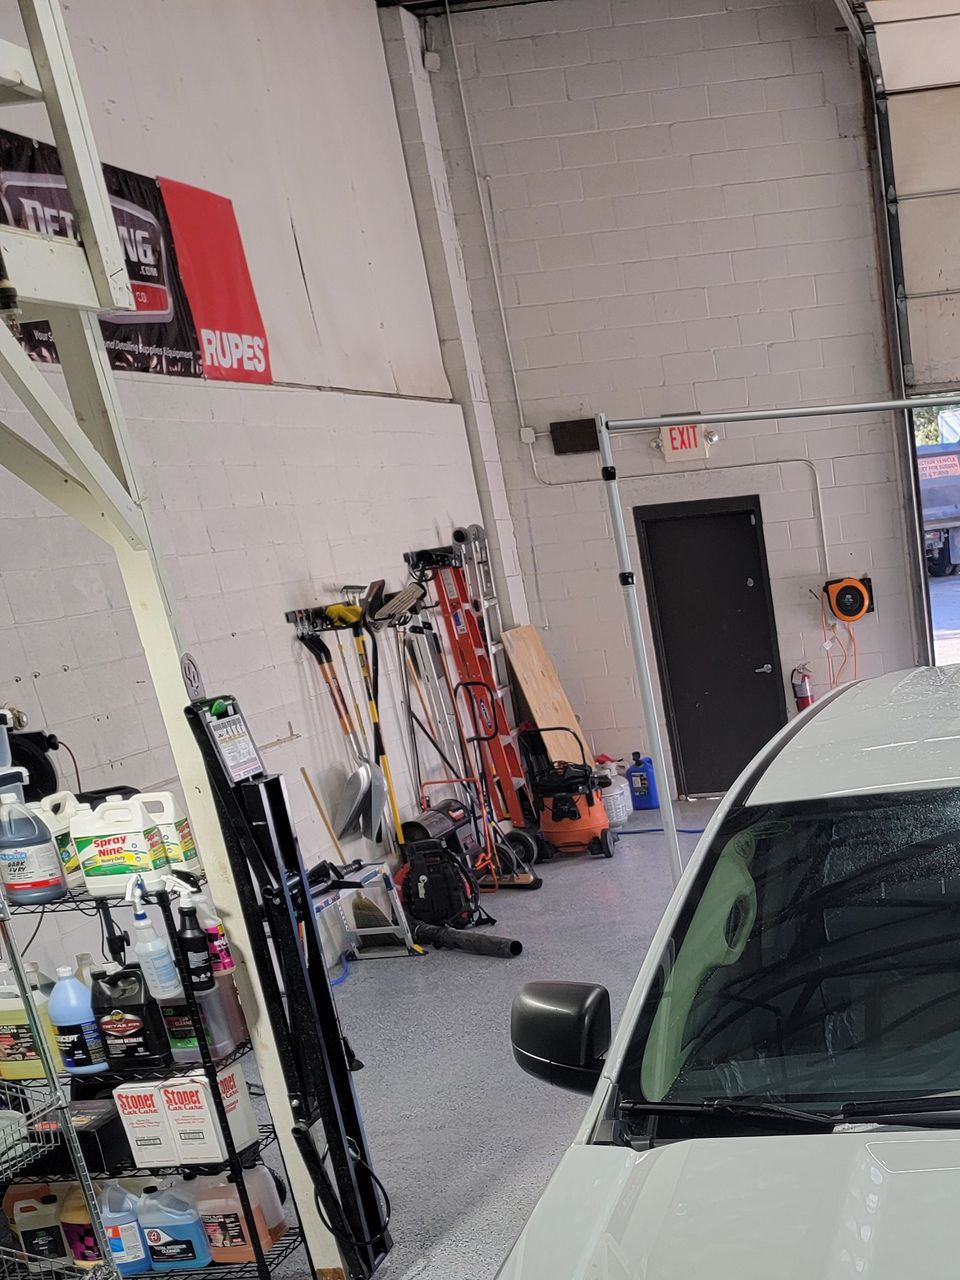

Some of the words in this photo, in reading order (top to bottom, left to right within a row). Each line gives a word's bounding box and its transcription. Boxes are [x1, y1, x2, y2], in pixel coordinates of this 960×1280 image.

[201, 328, 265, 373] RUPES
[668, 425, 698, 451] EXIT
[93, 835, 127, 849] Spray
[98, 846, 124, 858] Nine
[117, 1093, 156, 1110] Stoner
[163, 1088, 201, 1105] Stoner
